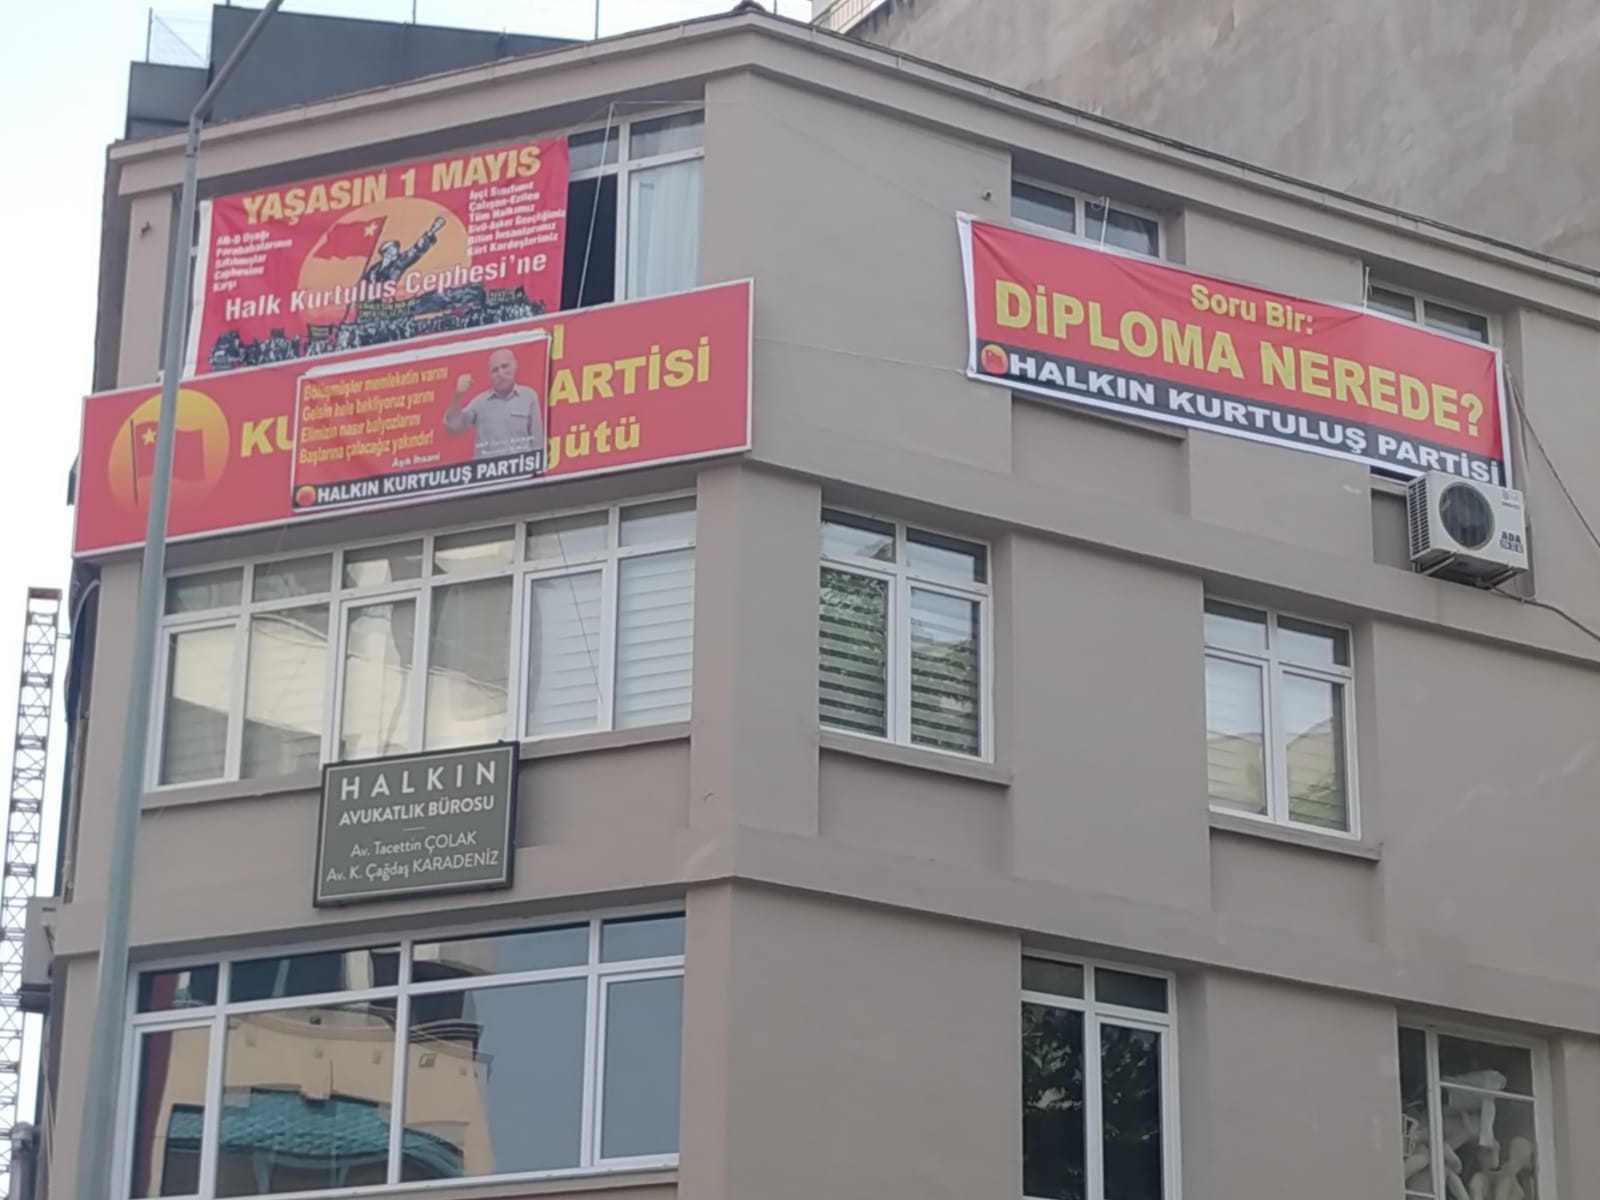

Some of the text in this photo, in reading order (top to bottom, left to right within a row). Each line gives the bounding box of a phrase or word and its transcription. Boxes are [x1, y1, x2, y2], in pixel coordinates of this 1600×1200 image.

[242, 146, 542, 225] YAŞASIN 1 MAYIS
[225, 295, 281, 321] Halk
[291, 279, 397, 312] Kurtuluş
[1190, 283, 1314, 336] Soru Bir:
[549, 336, 710, 407] ARTİSİ
[995, 279, 1485, 437] DİPLOMA NEREDE?
[1008, 353, 1500, 486] HALKIN KURTULUŞ PARTİSİ
[317, 451, 541, 504] HALKIN KURTULUŞ PARTİSİ
[341, 760, 496, 801] HALKIN
[338, 795, 495, 826] AVUKATLIK BÜROSU
[326, 848, 500, 882] Av. K. Çağdaş KARADENİZ
[350, 831, 478, 857] Av. Tacettin ÇOLAK
